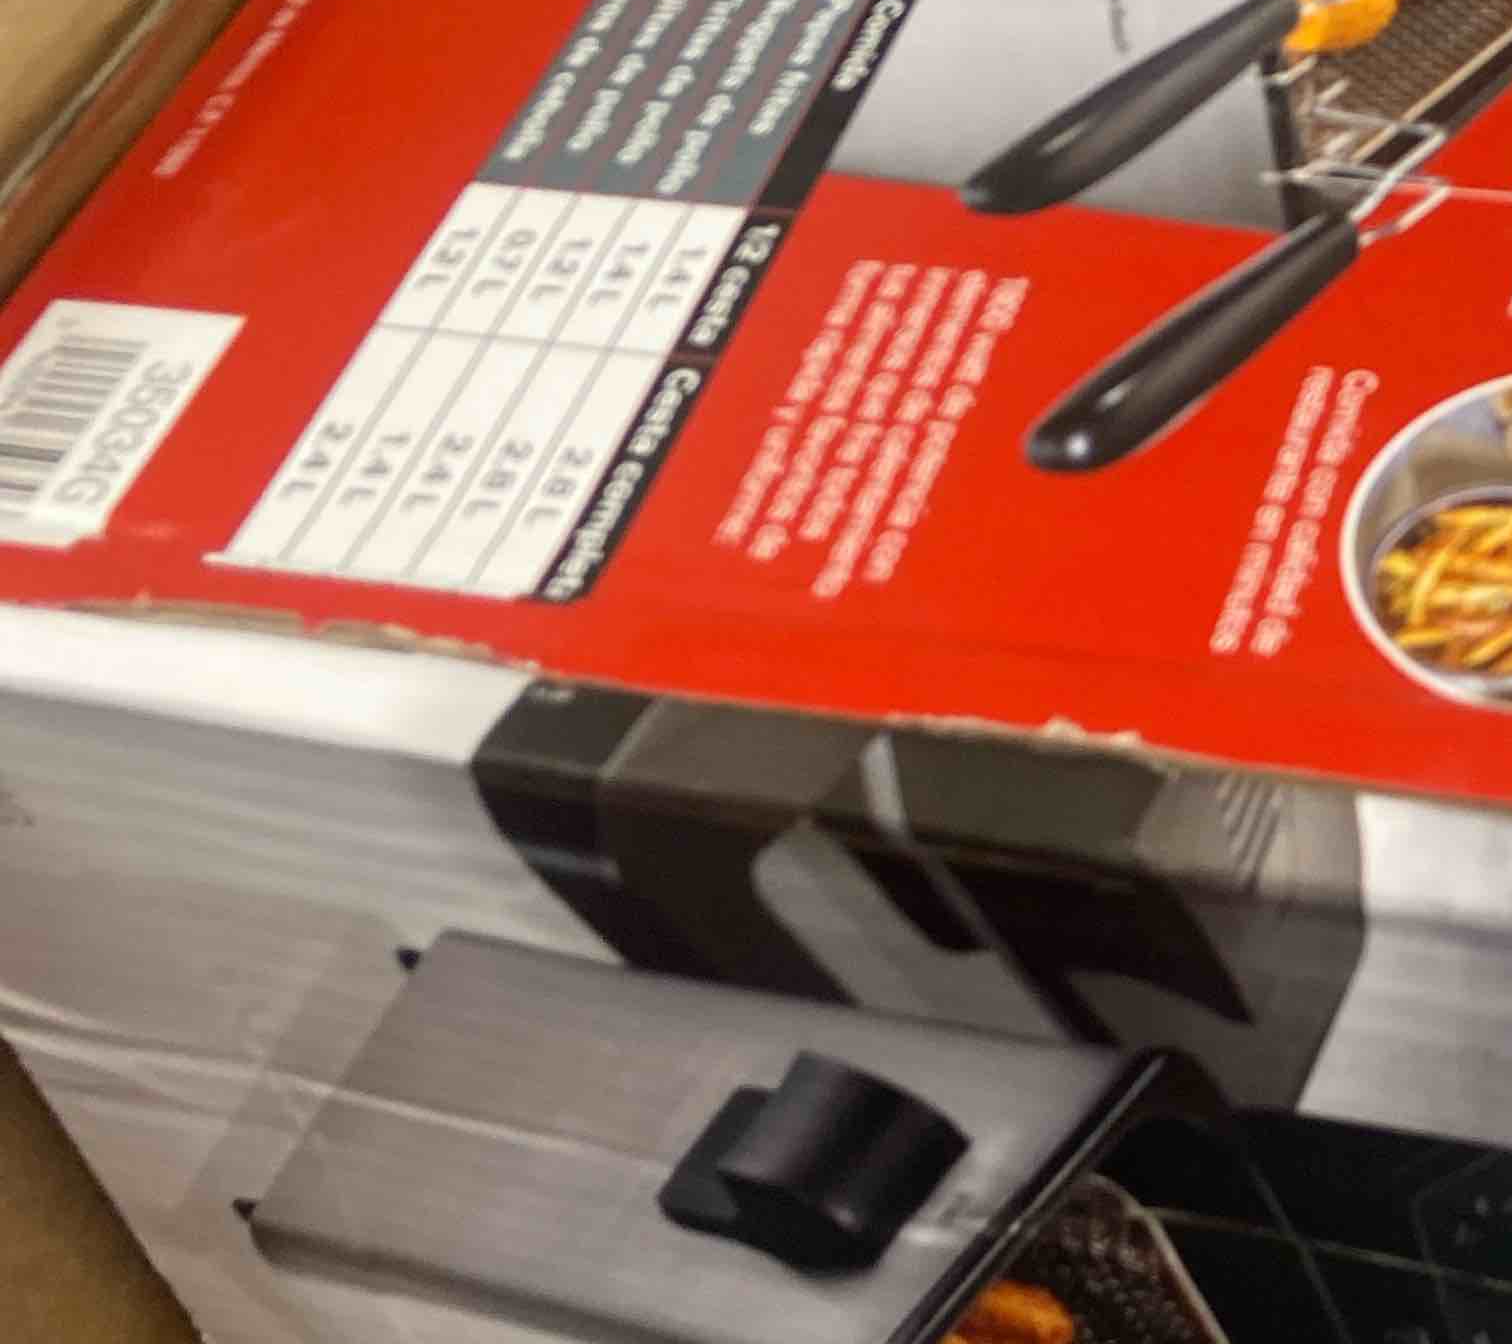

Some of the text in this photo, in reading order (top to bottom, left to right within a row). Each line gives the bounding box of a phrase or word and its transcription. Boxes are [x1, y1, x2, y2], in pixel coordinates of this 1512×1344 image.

[565, 35, 600, 67] de
[610, 52, 645, 85] de
[658, 64, 694, 97] de
[503, 71, 575, 160] cebolla
[567, 88, 621, 151] pollo
[616, 100, 670, 164] pollo
[698, 93, 733, 126] de
[749, 69, 809, 135] fritas
[657, 129, 710, 194] pollo
[688, 265, 749, 345] cesta
[825, 259, 884, 329] forma
[881, 266, 950, 370] inmersos
[822, 299, 895, 414] alimentos
[628, 367, 700, 456] Cesta
[858, 369, 898, 423] que
[938, 382, 974, 420] de
[53, 361, 192, 504] 35034G
[813, 270, 986, 597] elementos de calentamiento
[767, 414, 846, 522] favoritos
[799, 465, 857, 540] todos
[888, 419, 955, 528] potencia
[748, 521, 787, 560] de
[1210, 366, 1332, 652] restaurante en minutos
[1250, 369, 1378, 655] Comida con calidad de
[865, 527, 907, 581] con
